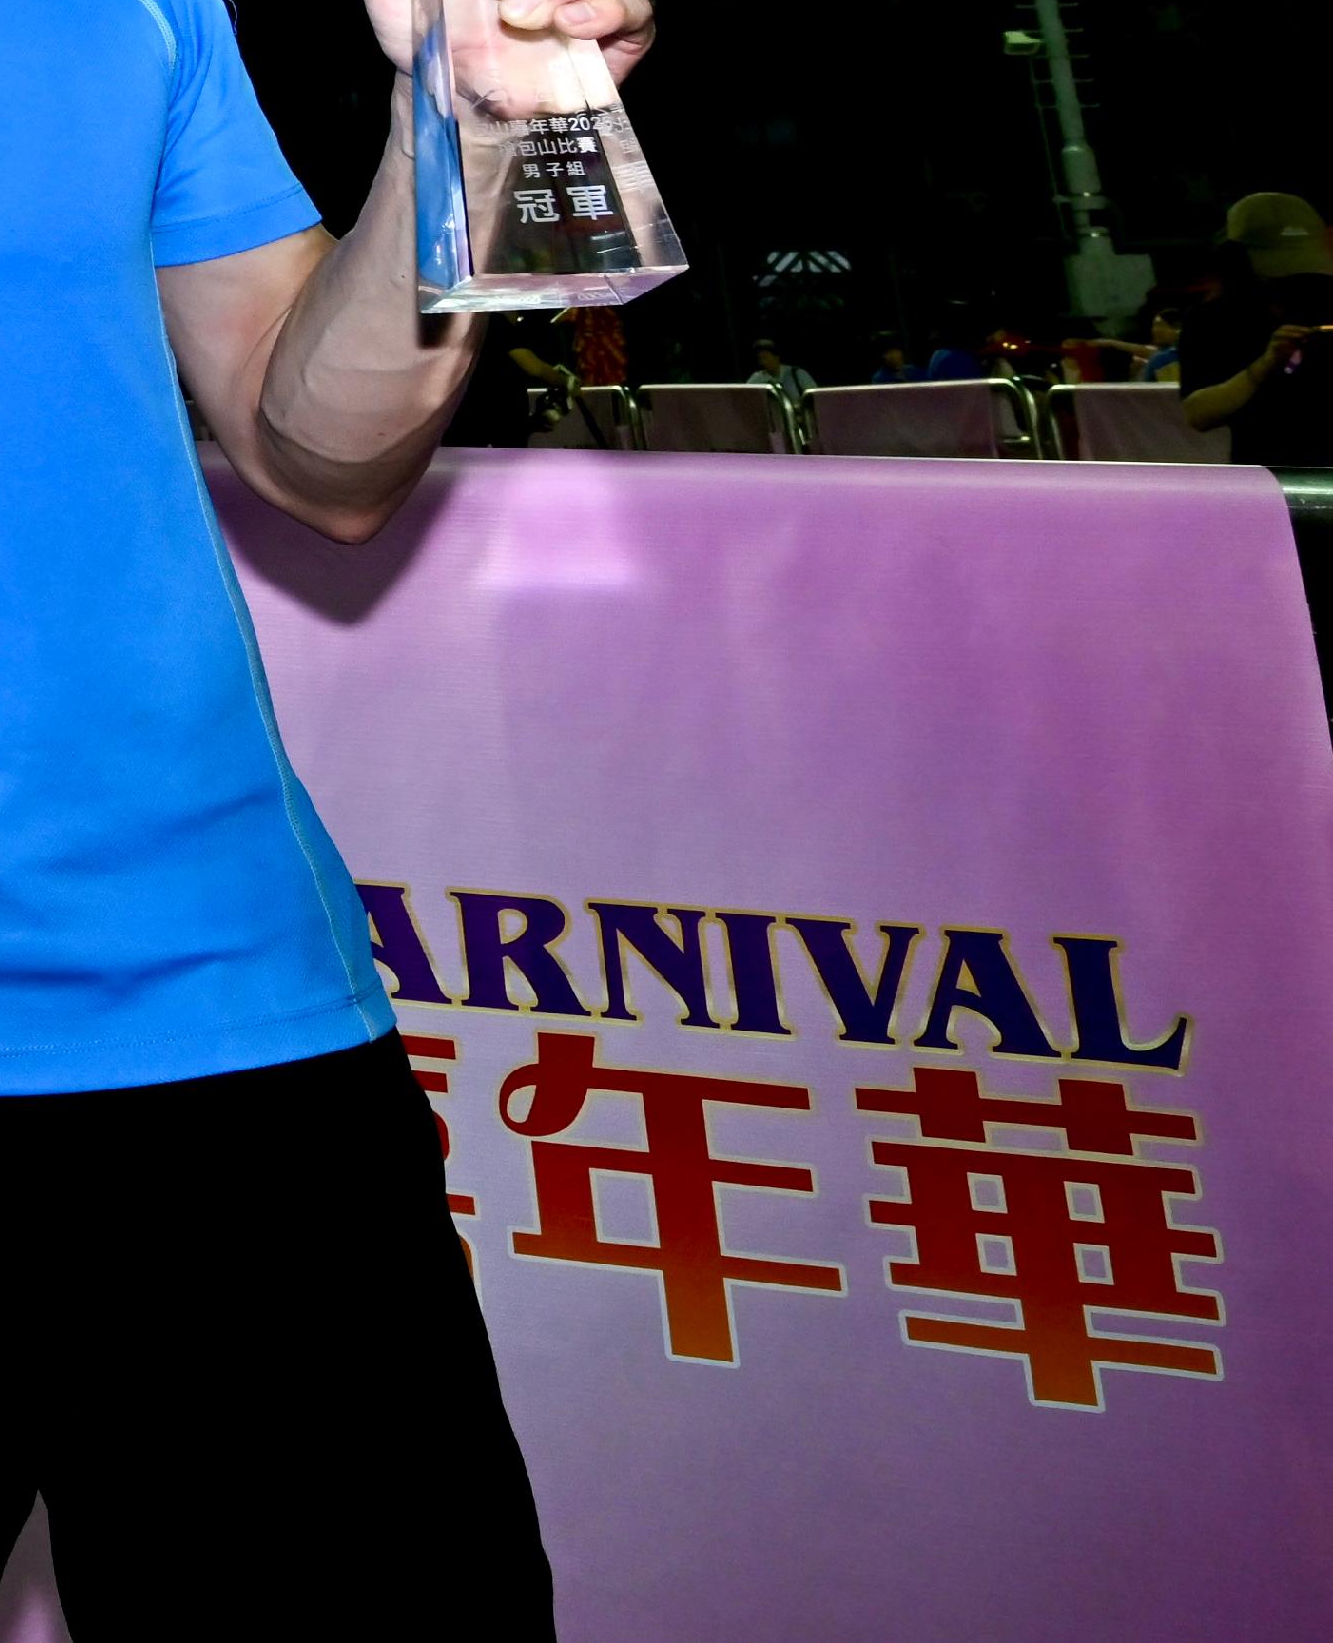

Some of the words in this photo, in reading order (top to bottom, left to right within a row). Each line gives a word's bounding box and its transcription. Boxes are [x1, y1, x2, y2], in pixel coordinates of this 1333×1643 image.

[513, 184, 614, 225] 冠軍
[522, 160, 586, 179] 男子組
[353, 882, 1194, 1076] ARNIVAL
[401, 1030, 1226, 1413] 年華
